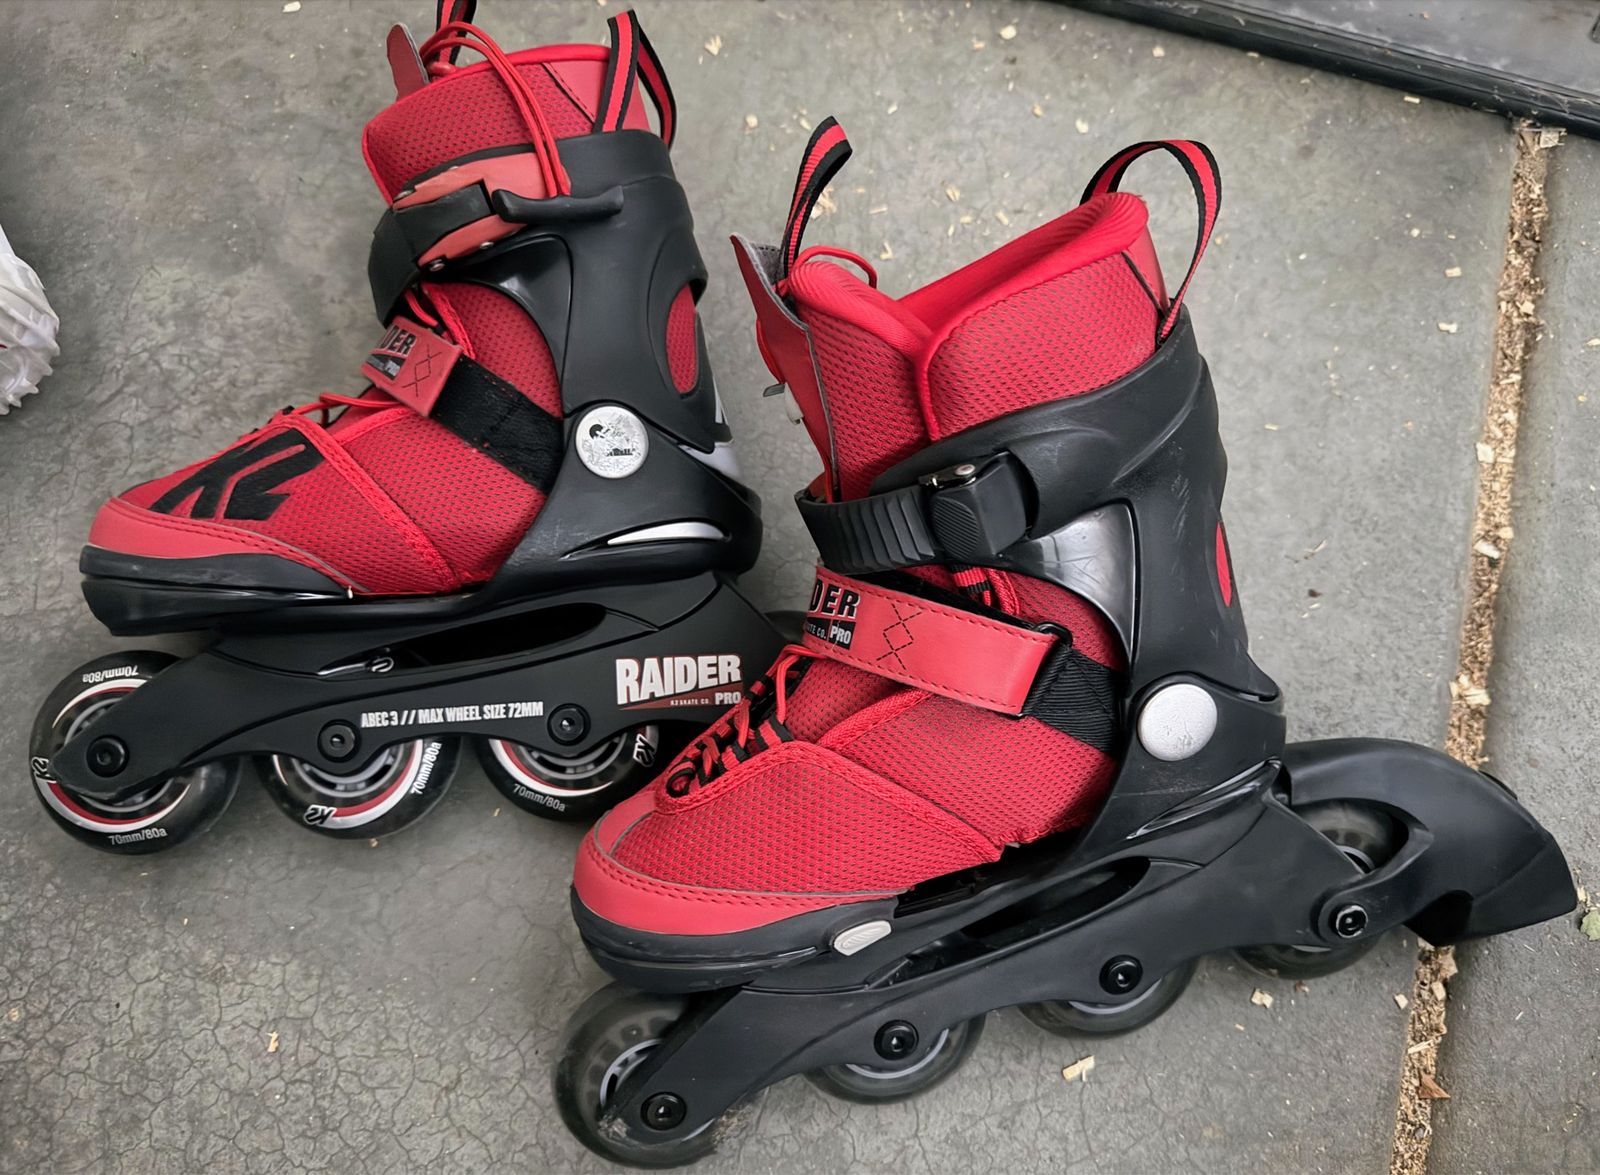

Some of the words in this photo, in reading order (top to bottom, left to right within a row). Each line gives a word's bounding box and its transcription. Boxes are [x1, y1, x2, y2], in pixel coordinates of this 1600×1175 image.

[830, 626, 852, 644] PRO
[82, 665, 139, 683] 70mm/80a
[616, 654, 741, 705] RAIDER
[715, 692, 741, 705] PRO
[361, 712, 390, 728] ABEC
[389, 711, 399, 726] 3
[418, 708, 444, 724] MAX
[445, 705, 482, 721] WHEEL
[483, 703, 506, 719] SIZE
[508, 701, 544, 717] 72MM
[410, 741, 442, 795] 70mm/80a
[513, 783, 566, 813] 70mm/80a
[108, 827, 168, 845] 70mm/80a
